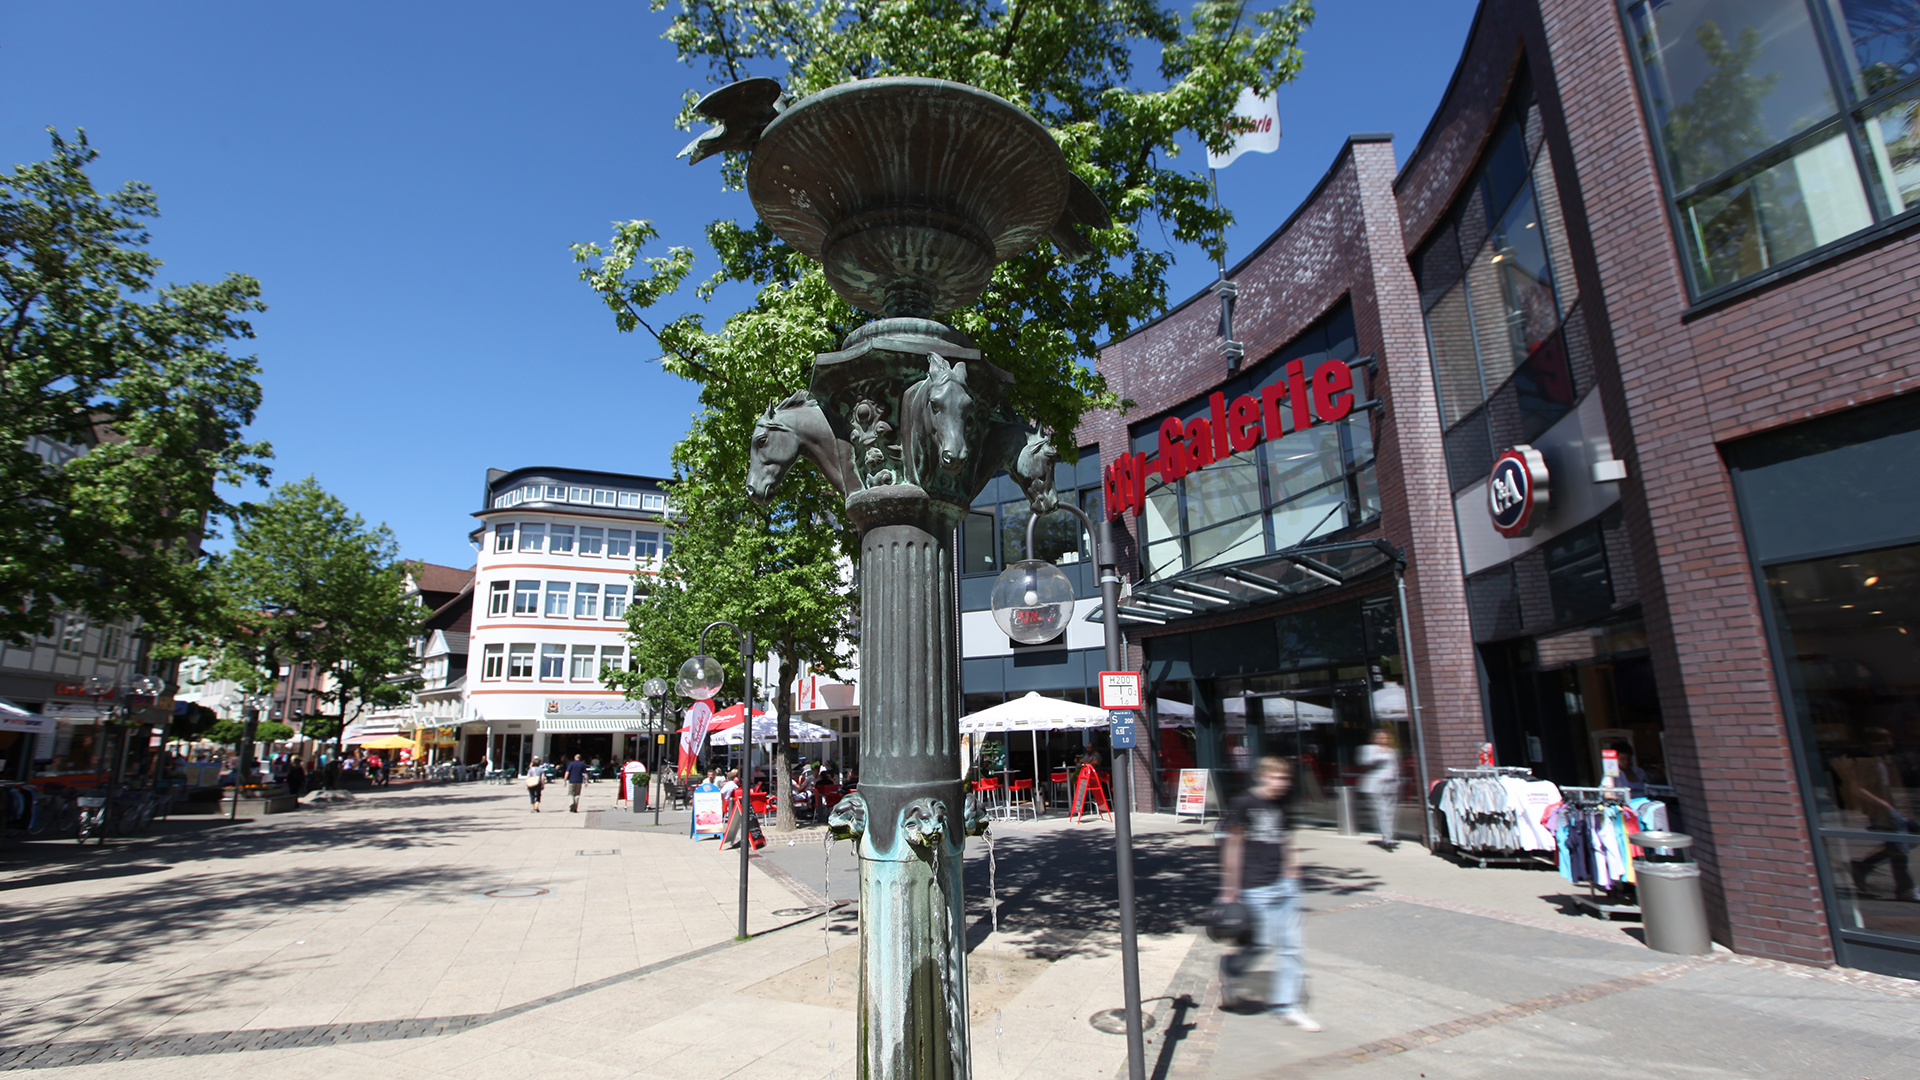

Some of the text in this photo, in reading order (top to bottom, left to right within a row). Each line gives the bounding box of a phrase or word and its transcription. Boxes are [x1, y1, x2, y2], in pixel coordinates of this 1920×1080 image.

[1103, 357, 1355, 522] City-Galerie
[1490, 468, 1524, 516] C&A
[1111, 715, 1118, 724] S
[1124, 717, 1134, 725] 200
